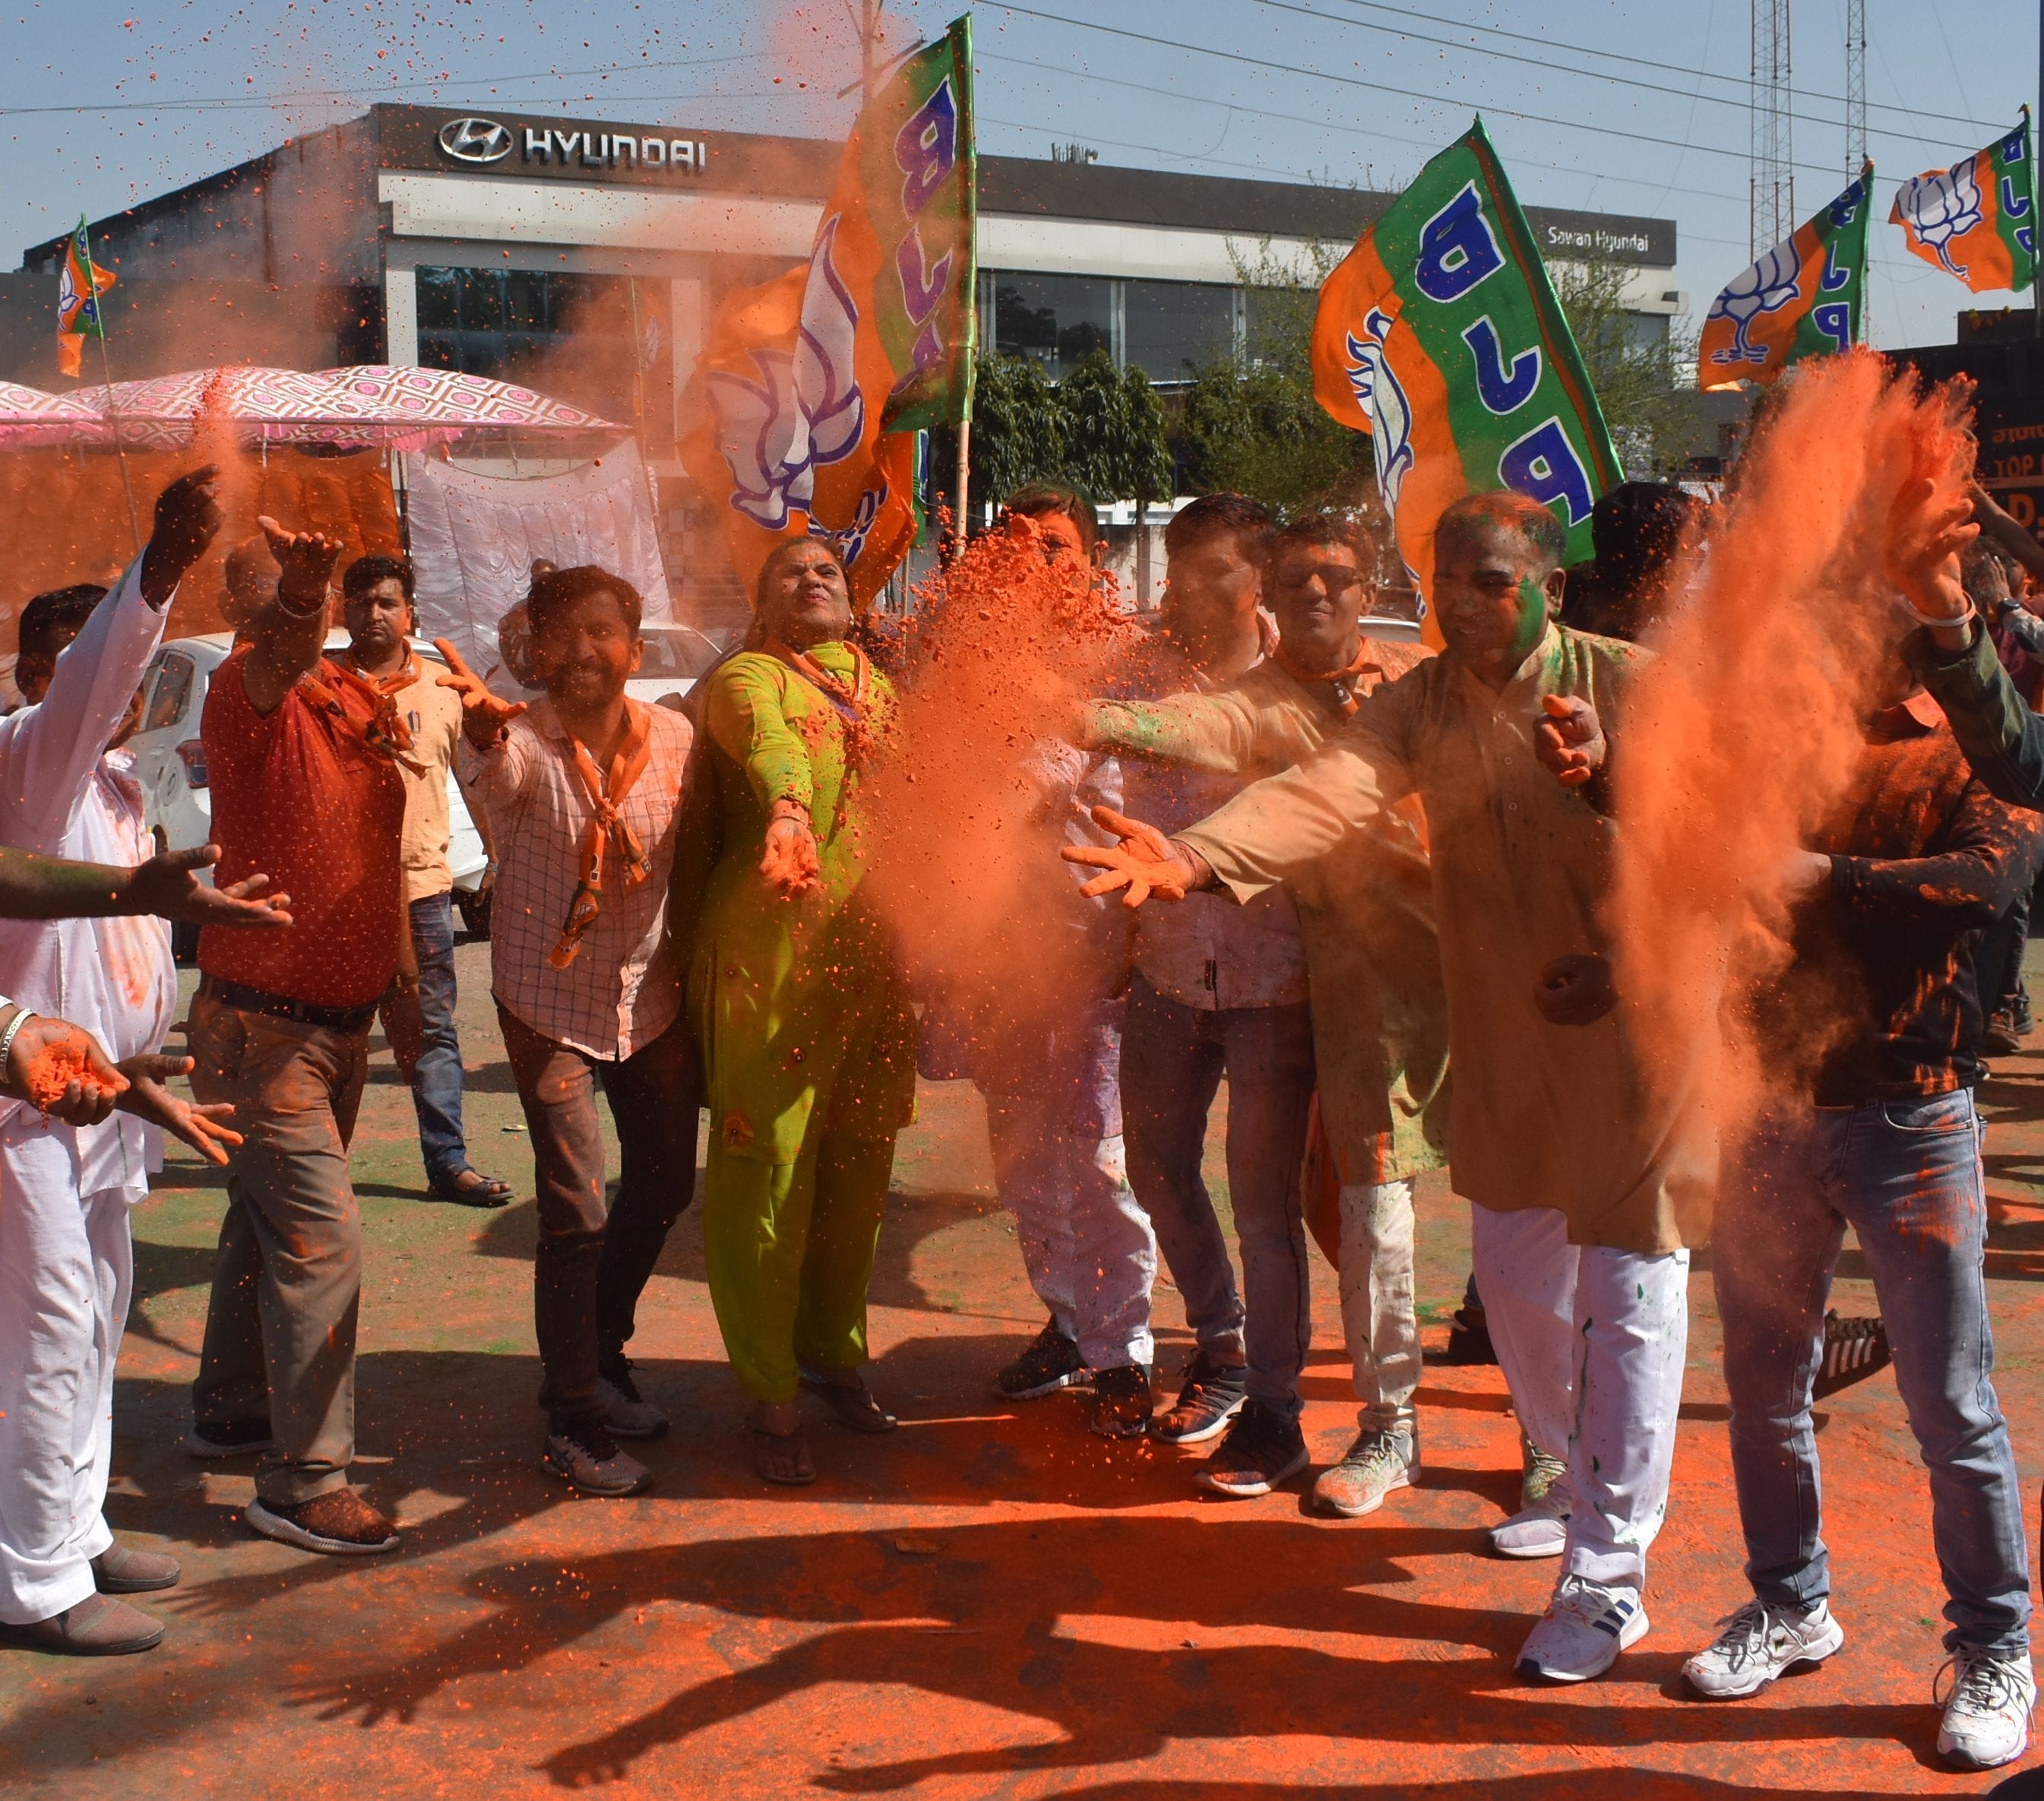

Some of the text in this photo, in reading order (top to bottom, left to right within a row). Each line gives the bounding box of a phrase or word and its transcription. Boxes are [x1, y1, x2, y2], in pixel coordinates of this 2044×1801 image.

[524, 128, 706, 173] HYUNDAI
[1596, 229, 1650, 253] Hyundai
[1995, 454, 2034, 477] TOP
